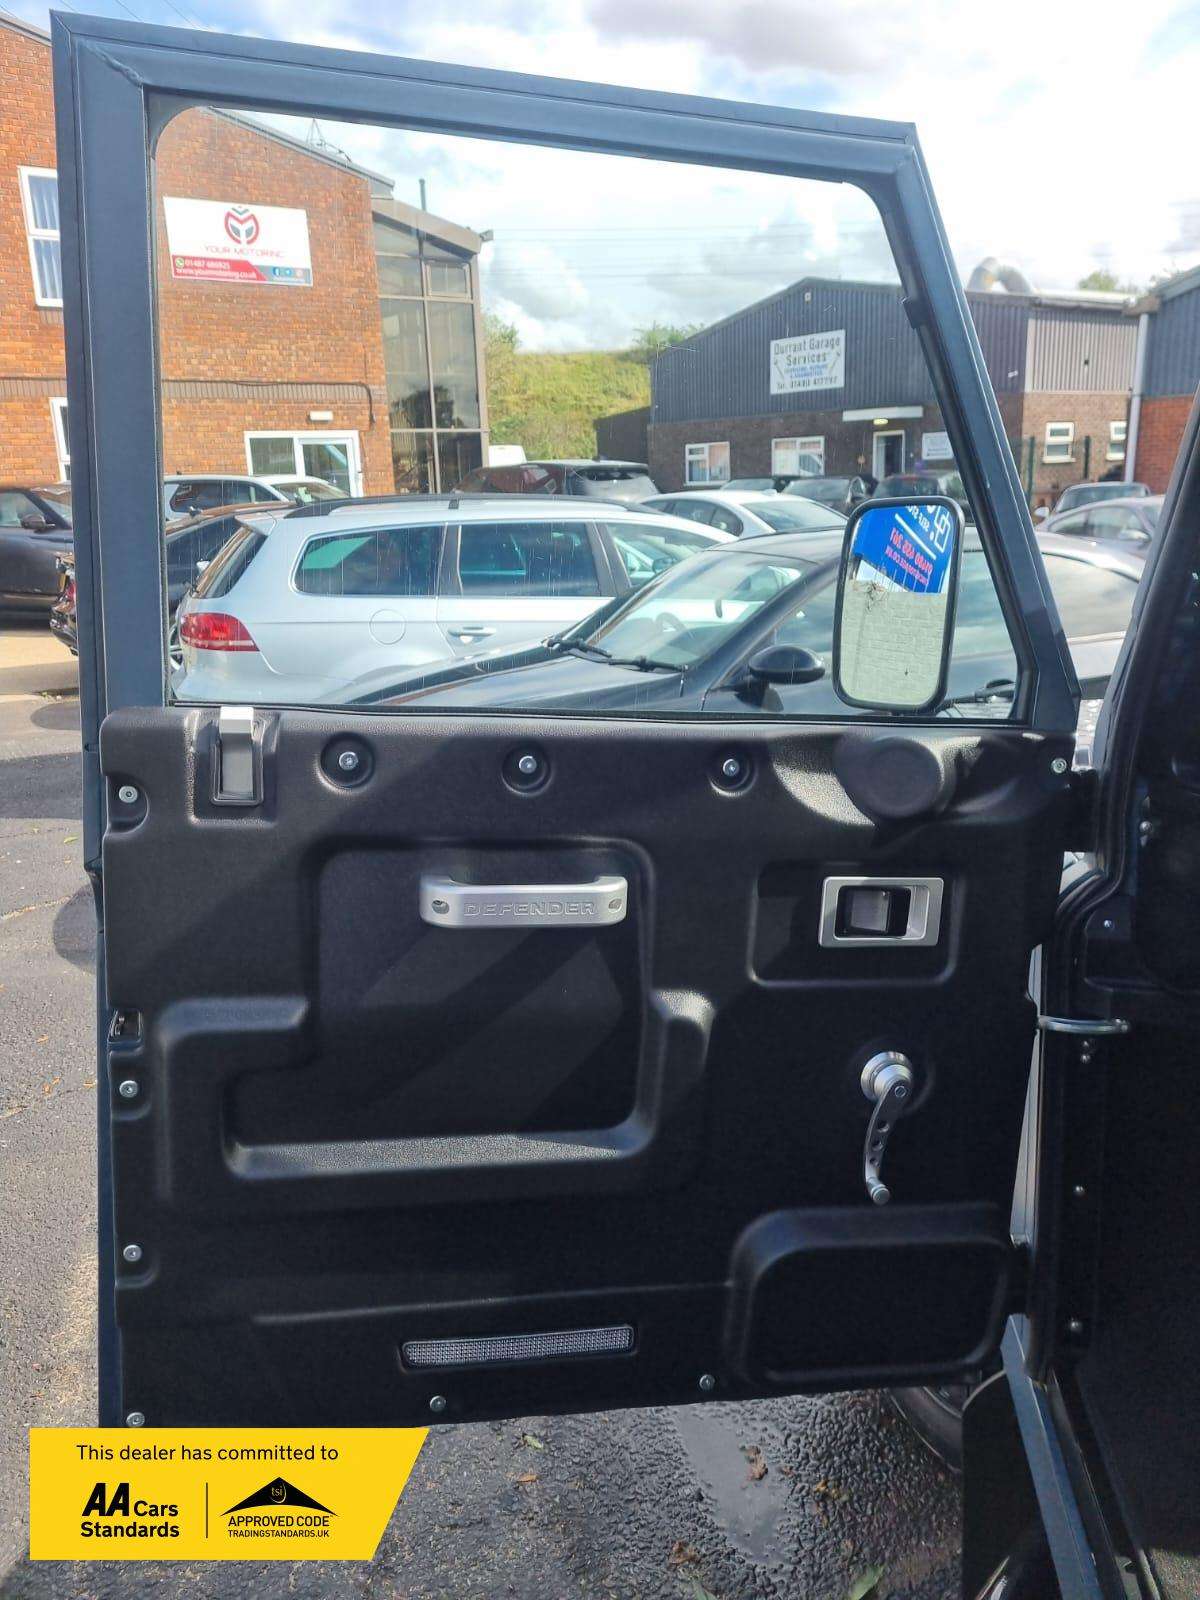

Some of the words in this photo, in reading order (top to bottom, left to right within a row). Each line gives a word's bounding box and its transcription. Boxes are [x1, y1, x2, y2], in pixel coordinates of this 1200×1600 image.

[774, 338, 808, 355] Durrant
[809, 335, 841, 352] Garage
[786, 352, 827, 366] Services
[463, 901, 595, 916] DEFENDER
